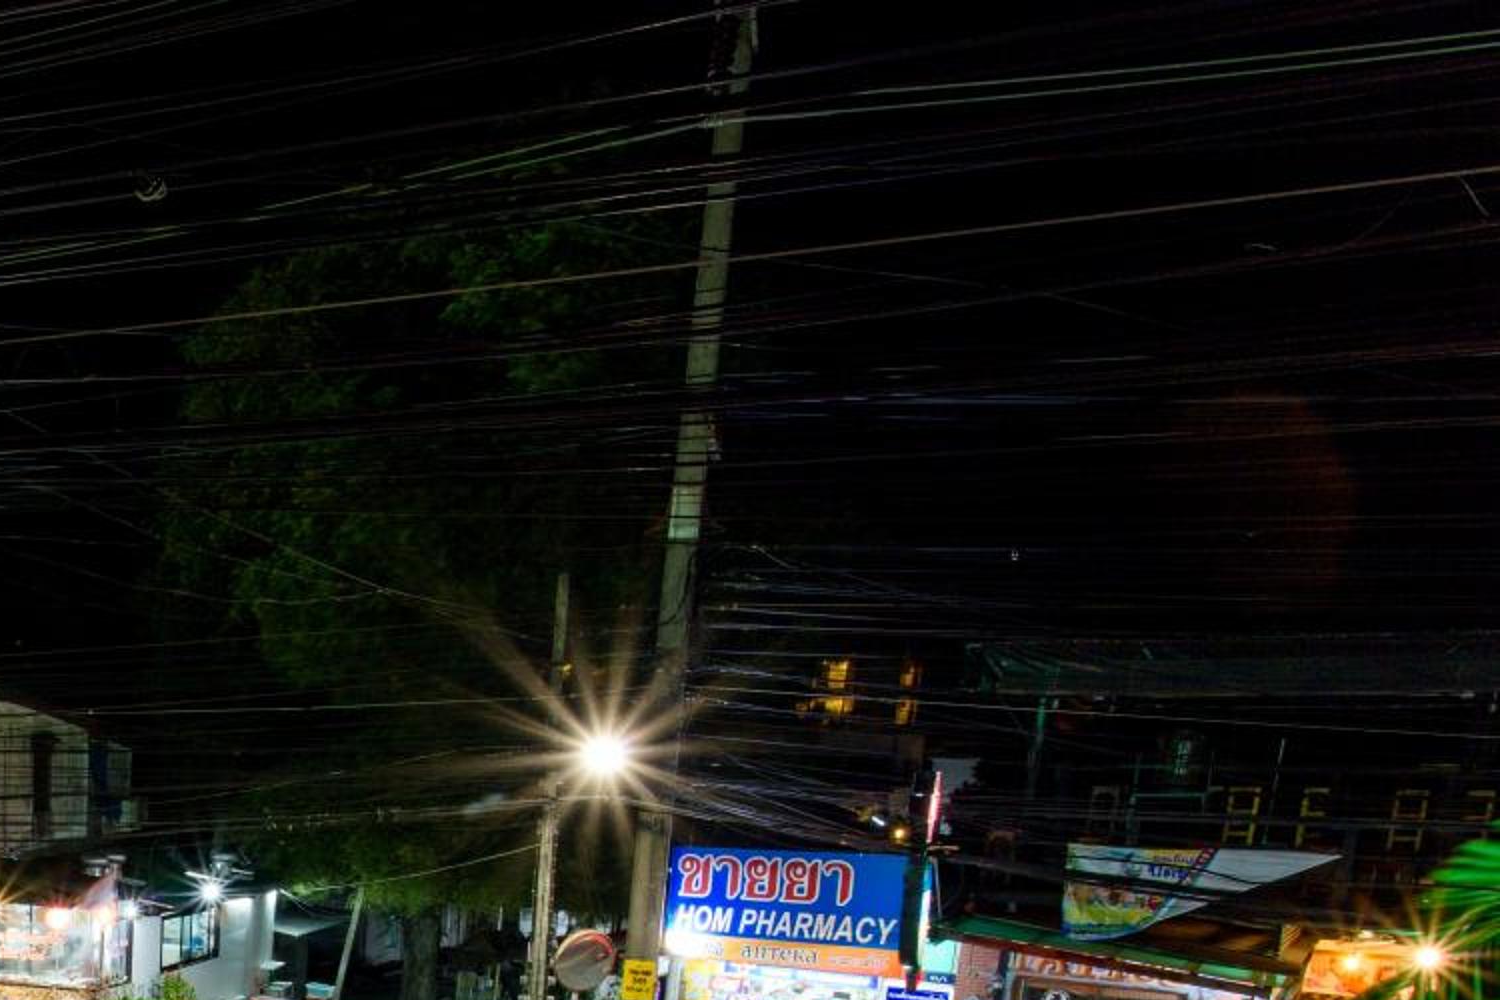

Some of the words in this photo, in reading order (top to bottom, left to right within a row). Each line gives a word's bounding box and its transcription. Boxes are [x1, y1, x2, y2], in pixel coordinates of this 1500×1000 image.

[678, 853, 855, 906] ขายยา
[674, 903, 735, 934] HOM
[739, 907, 898, 945] PHARMACY
